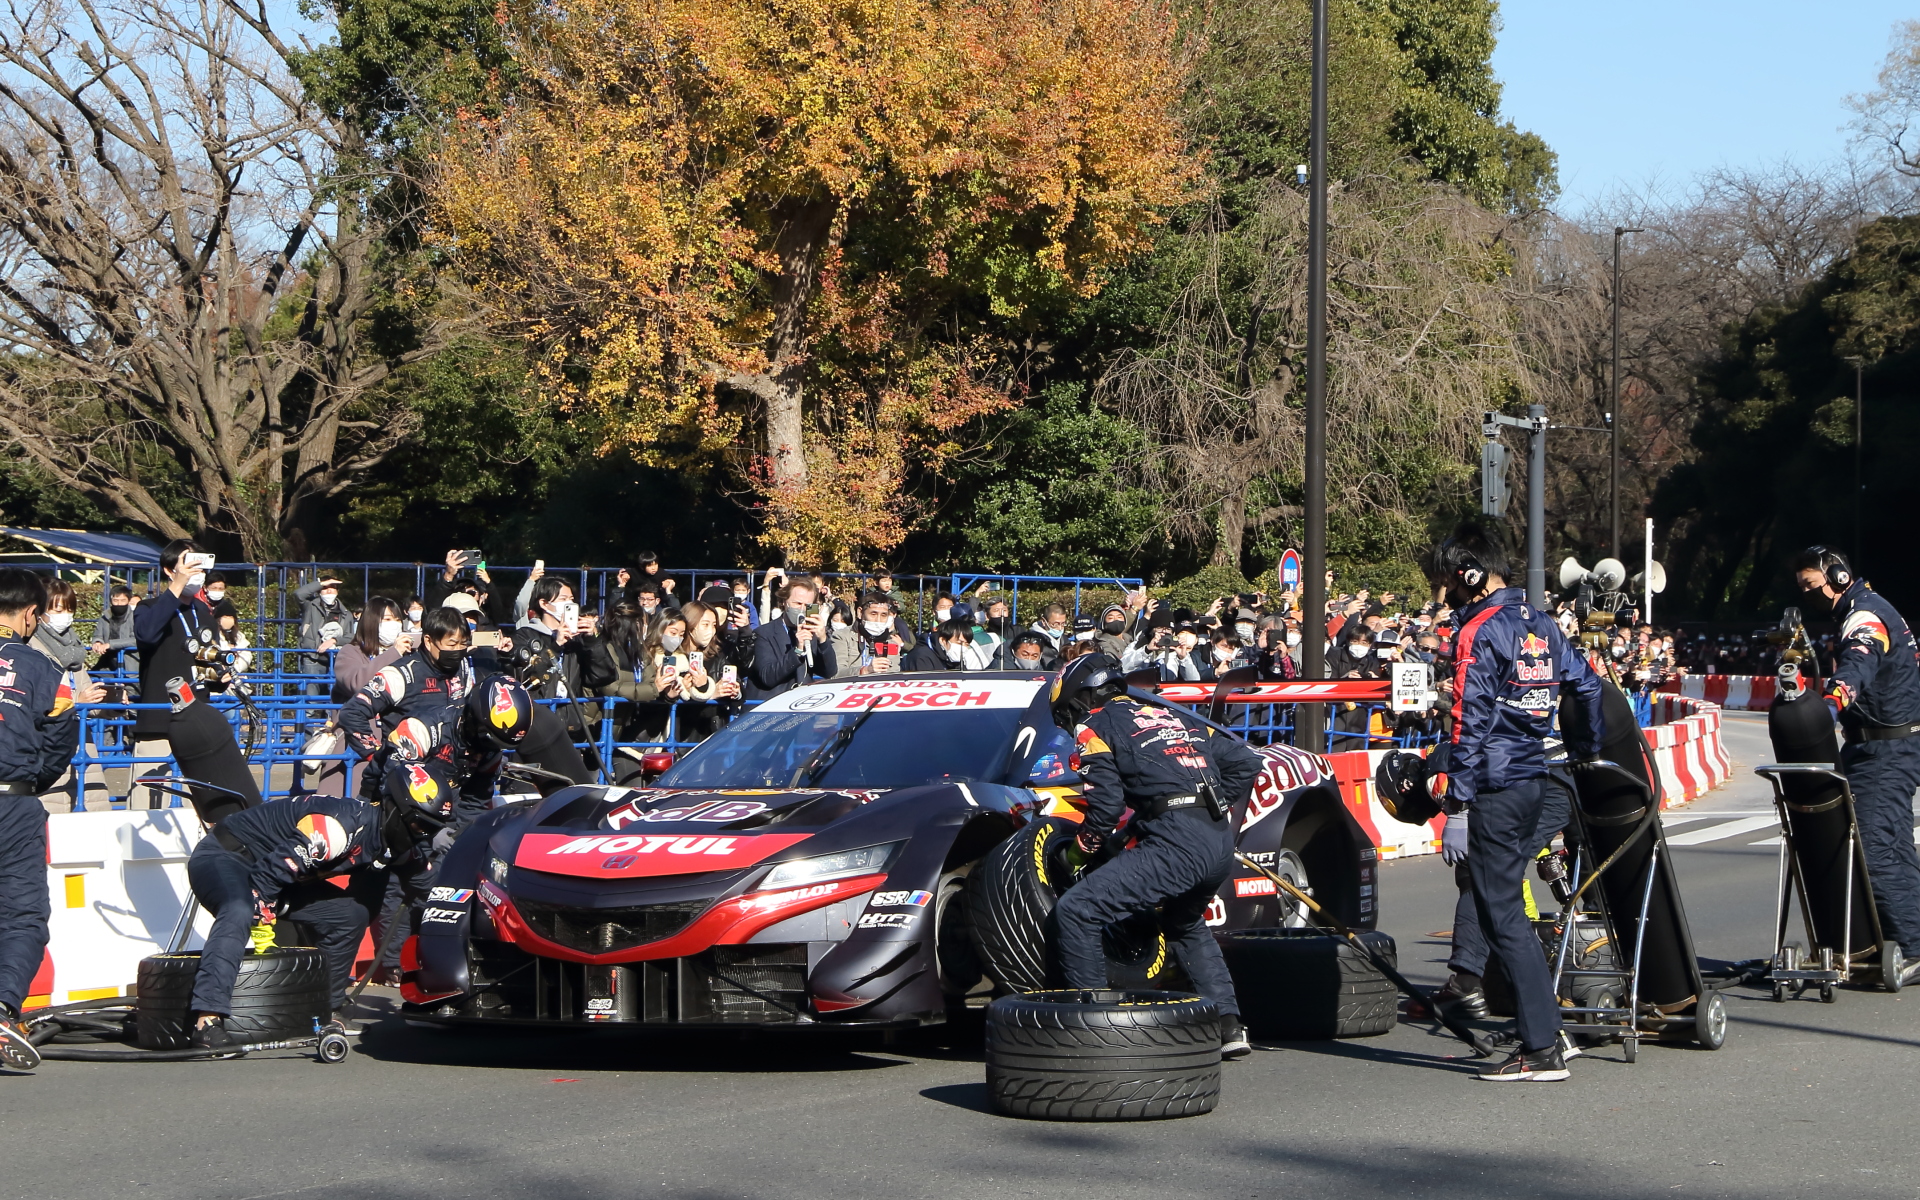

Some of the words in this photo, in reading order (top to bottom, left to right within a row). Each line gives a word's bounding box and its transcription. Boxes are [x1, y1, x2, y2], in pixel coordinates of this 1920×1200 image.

[841, 681, 966, 692] HONDA
[835, 691, 992, 709] BOSCH
[546, 836, 738, 855] MOTUL
[1034, 823, 1054, 886] DIREZZA
[755, 883, 839, 908] NLOP
[1238, 879, 1275, 895] MOTUL
[871, 891, 910, 907] SSR
[858, 913, 918, 925] HTFT
[1146, 932, 1166, 979] UNLOP
